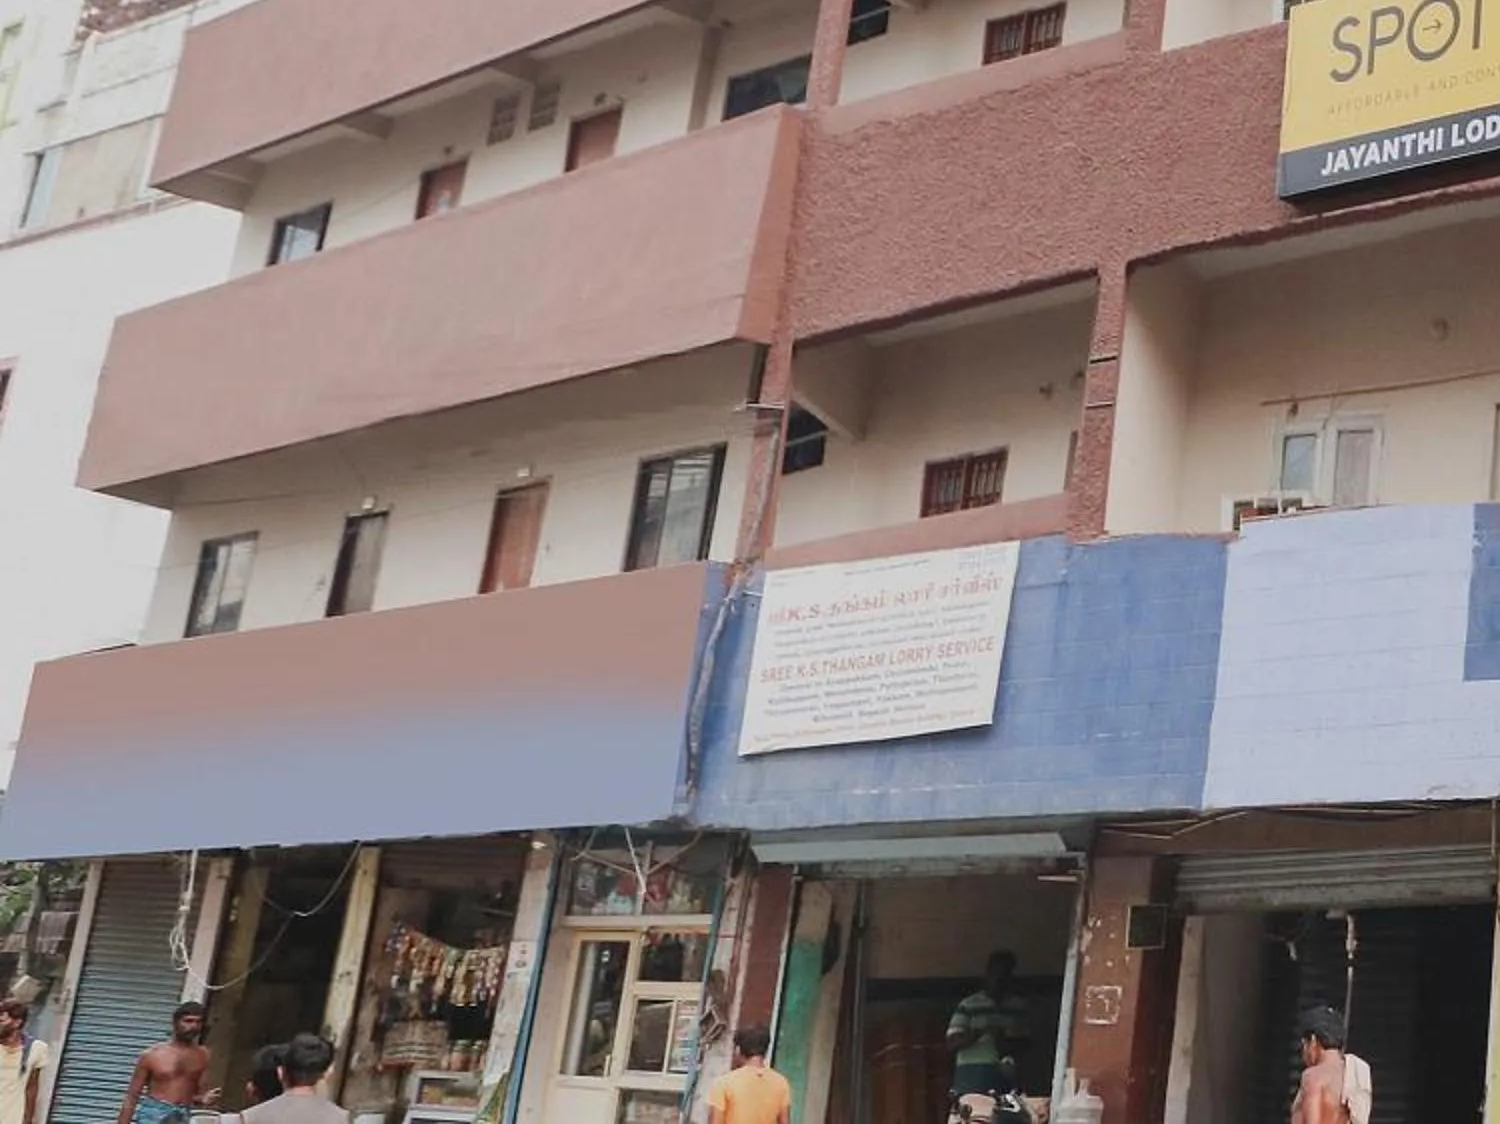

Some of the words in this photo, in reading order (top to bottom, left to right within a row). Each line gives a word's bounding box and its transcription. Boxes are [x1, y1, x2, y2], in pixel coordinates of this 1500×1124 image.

[1429, 75, 1458, 91] AND
[1320, 128, 1444, 177] JAYANTHI
[890, 644, 934, 667] LORRY
[936, 635, 995, 659] SERVICE
